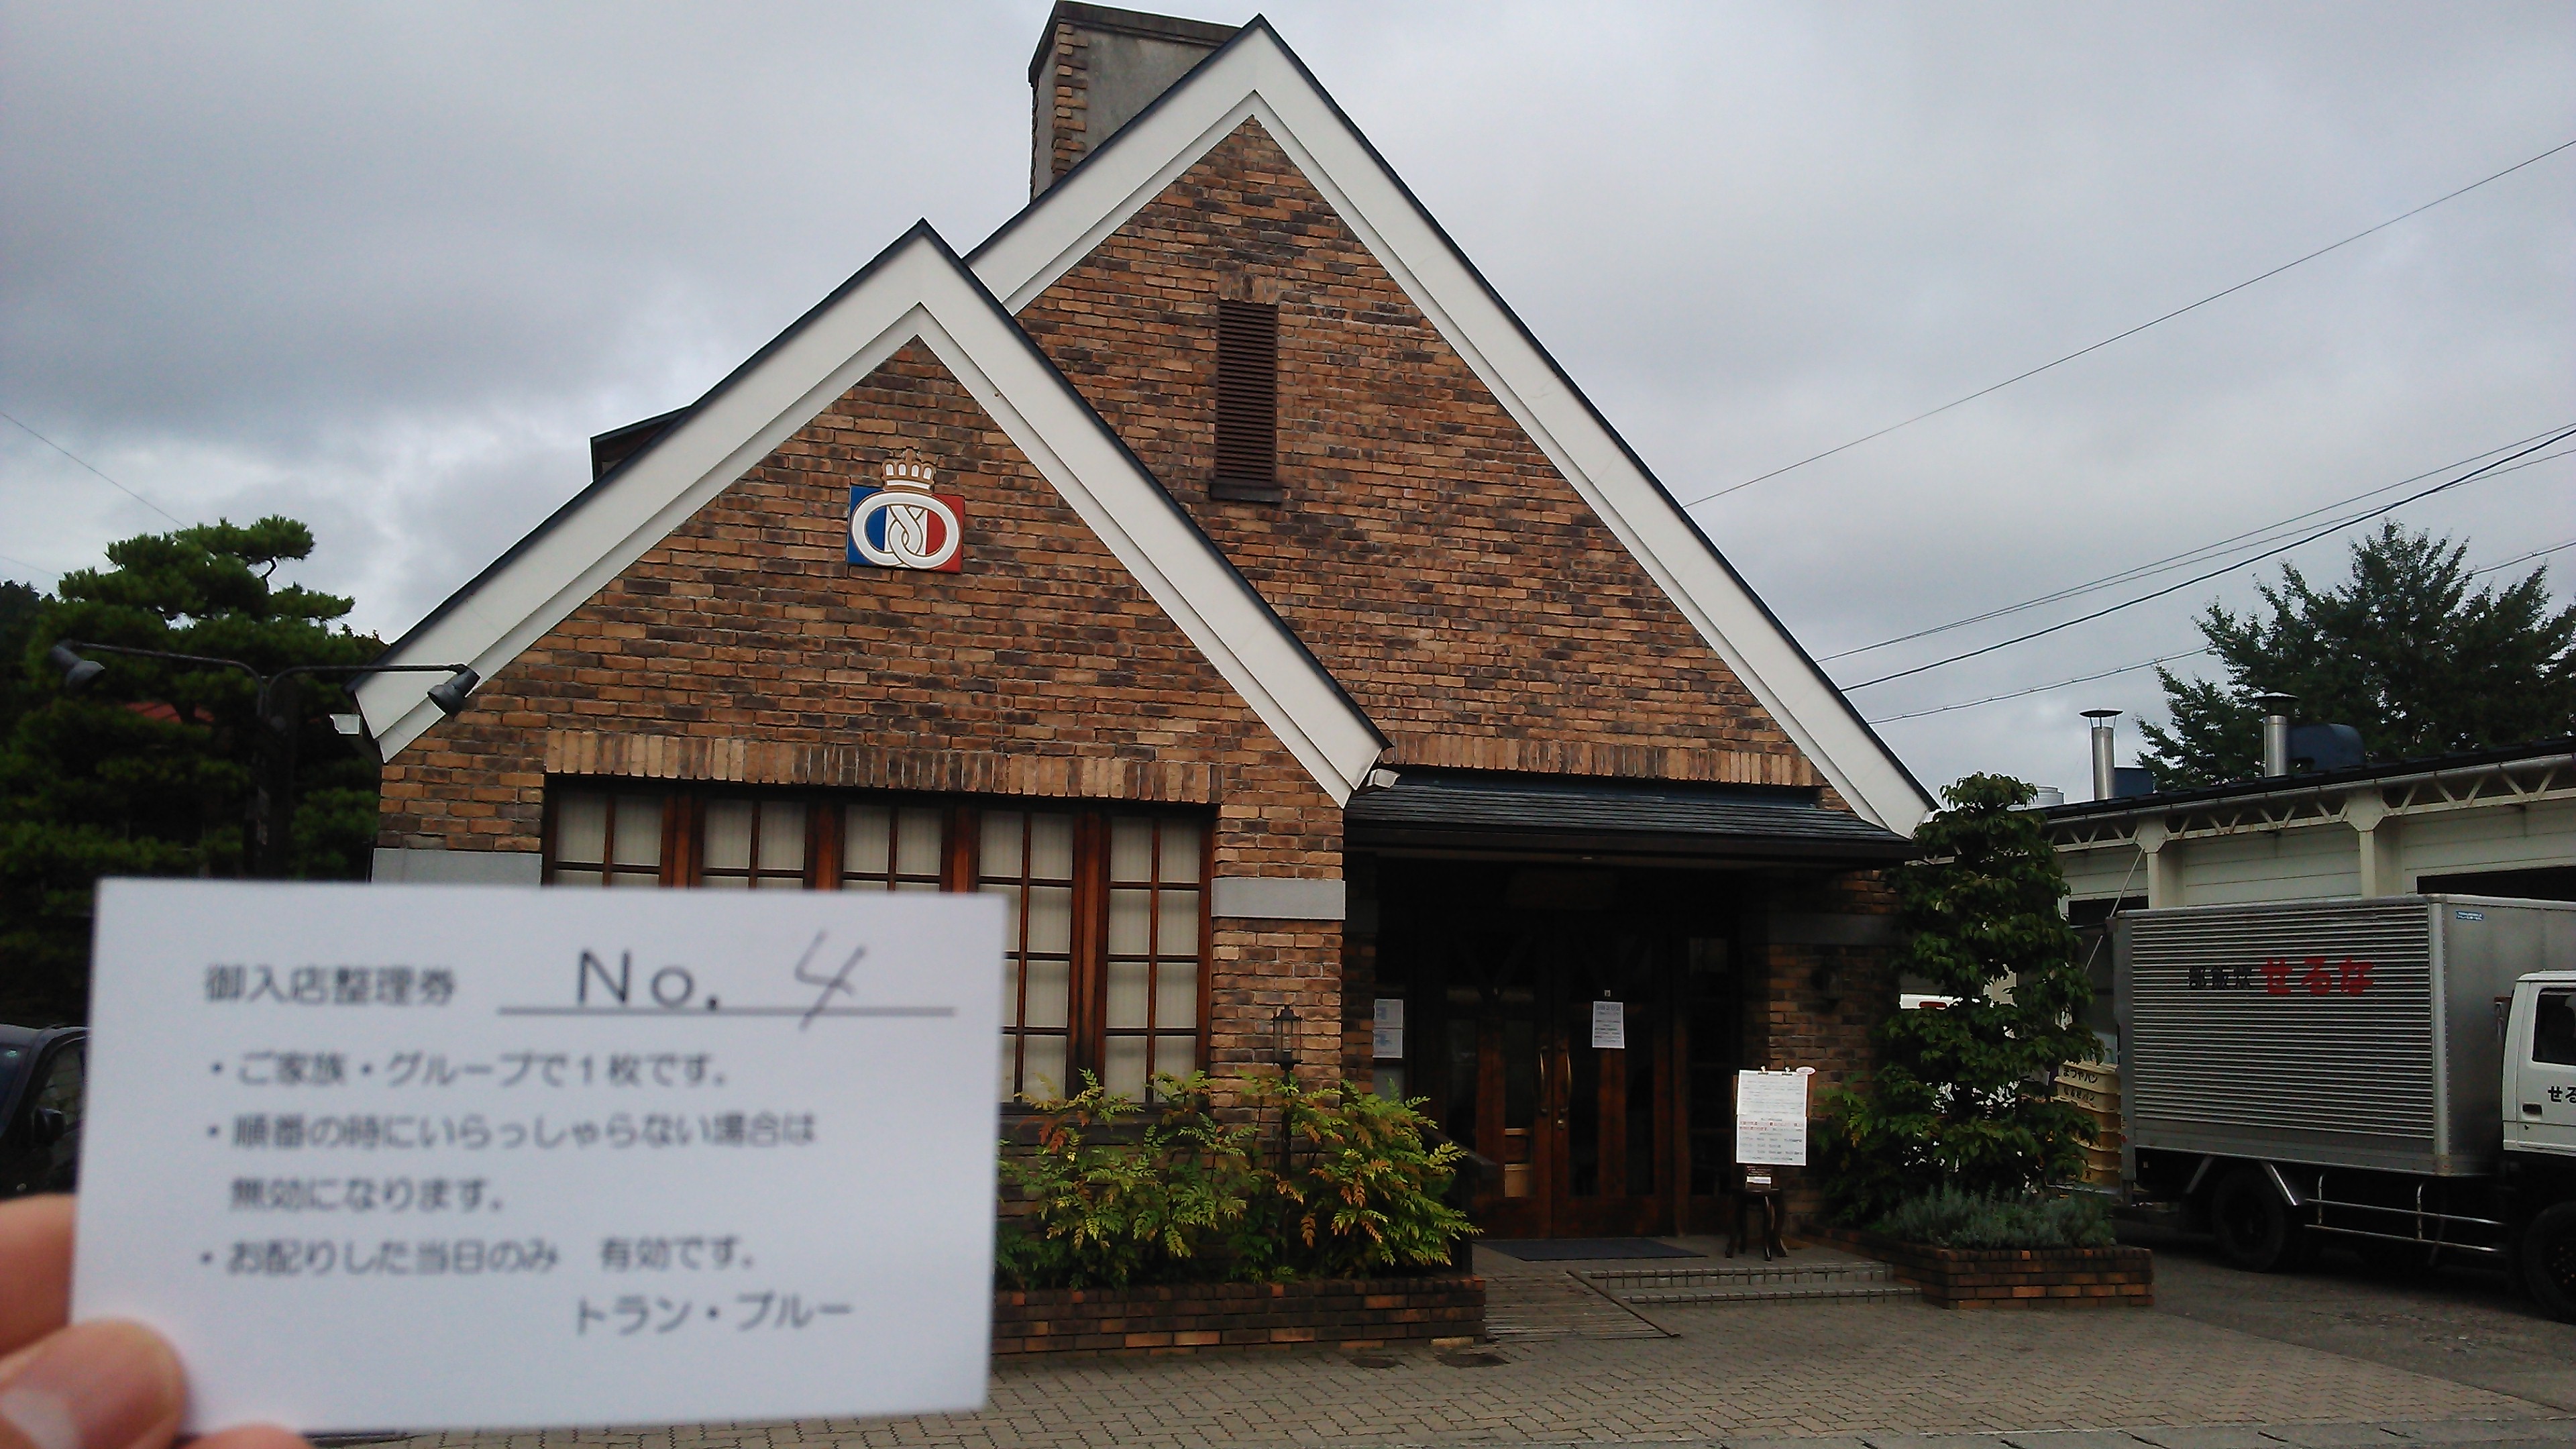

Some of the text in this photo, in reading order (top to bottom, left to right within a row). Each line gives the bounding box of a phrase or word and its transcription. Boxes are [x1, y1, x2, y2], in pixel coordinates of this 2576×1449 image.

[205, 948, 720, 1010] 御入店整理券 No.
[794, 930, 867, 1031] 4
[230, 1177, 502, 1212] 無効になります。
[600, 1235, 753, 1272] 有効です。
